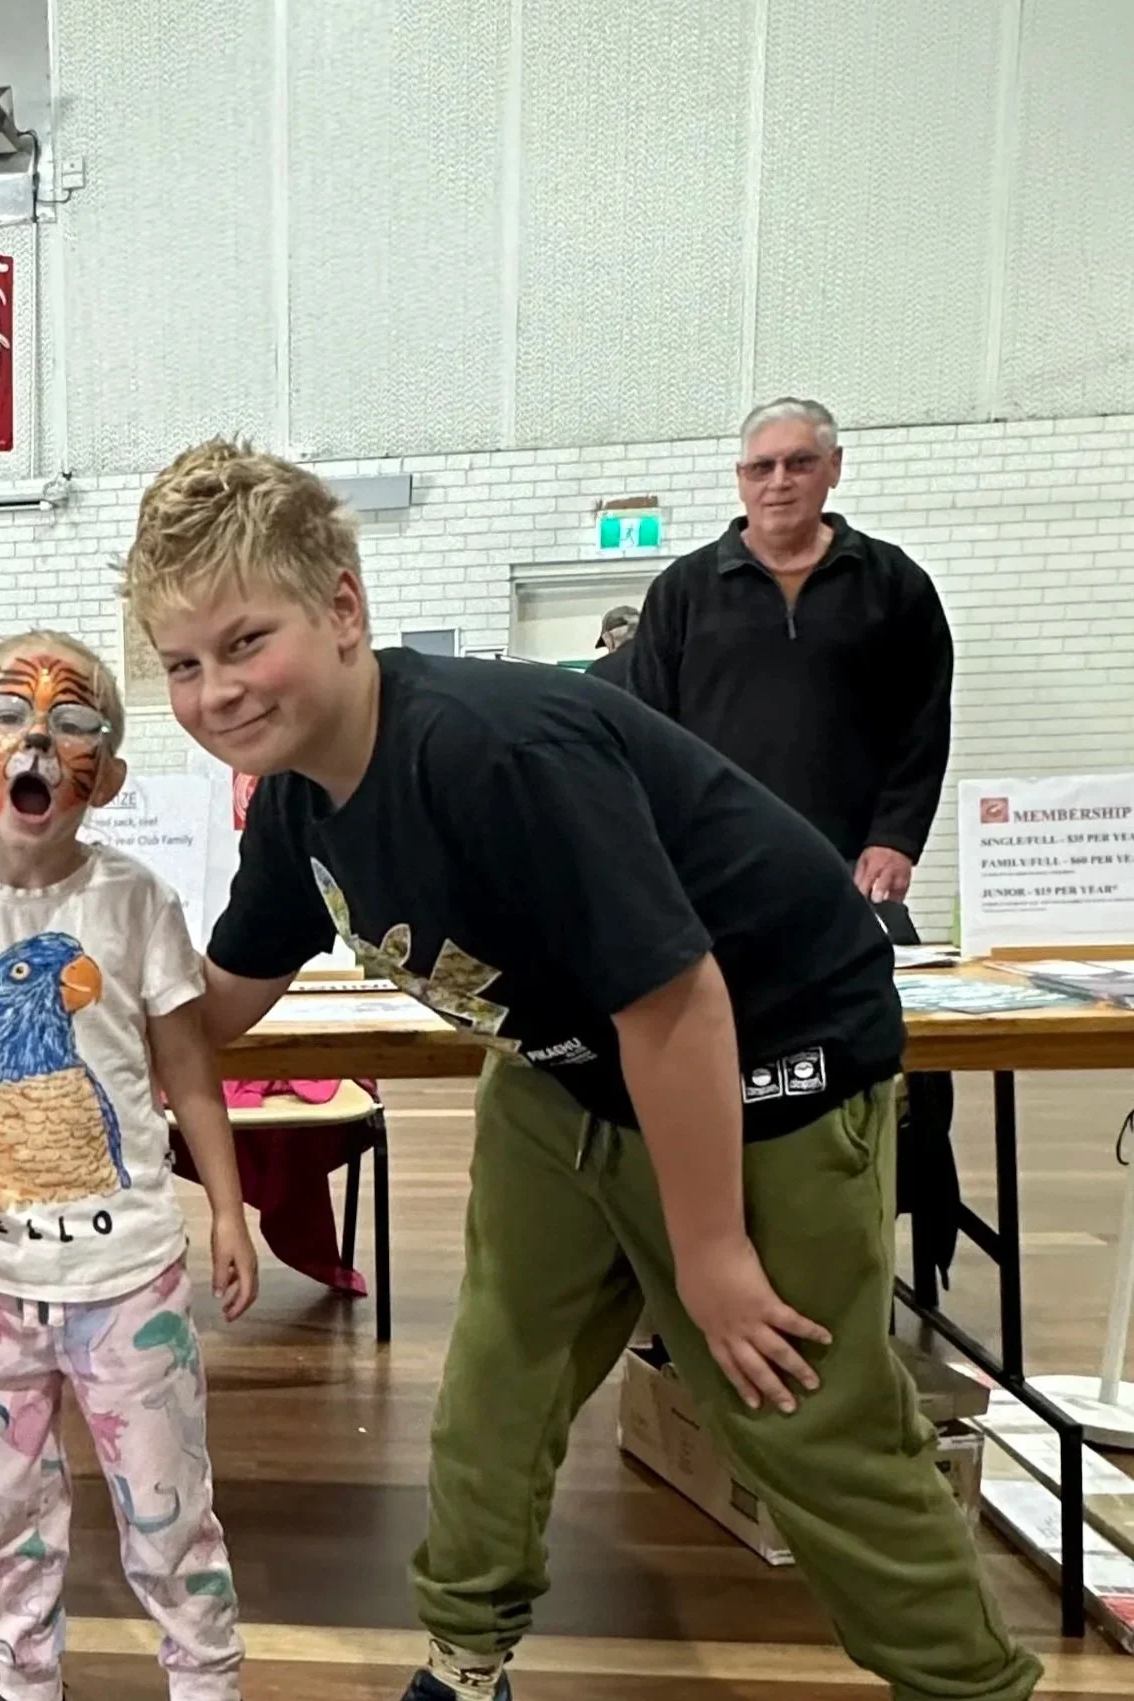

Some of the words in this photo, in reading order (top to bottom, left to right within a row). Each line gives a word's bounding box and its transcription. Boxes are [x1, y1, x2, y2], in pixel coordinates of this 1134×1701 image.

[1013, 806, 1132, 823] MEMBERSHIP
[138, 834, 160, 846] Club
[162, 834, 194, 847] Family
[1086, 832, 1110, 844] PER
[1112, 832, 1134, 843] YEA
[1090, 854, 1113, 865] PER
[1116, 853, 1134, 864] YE
[981, 887, 1026, 899] JUNIOR
[1054, 885, 1077, 896] PER
